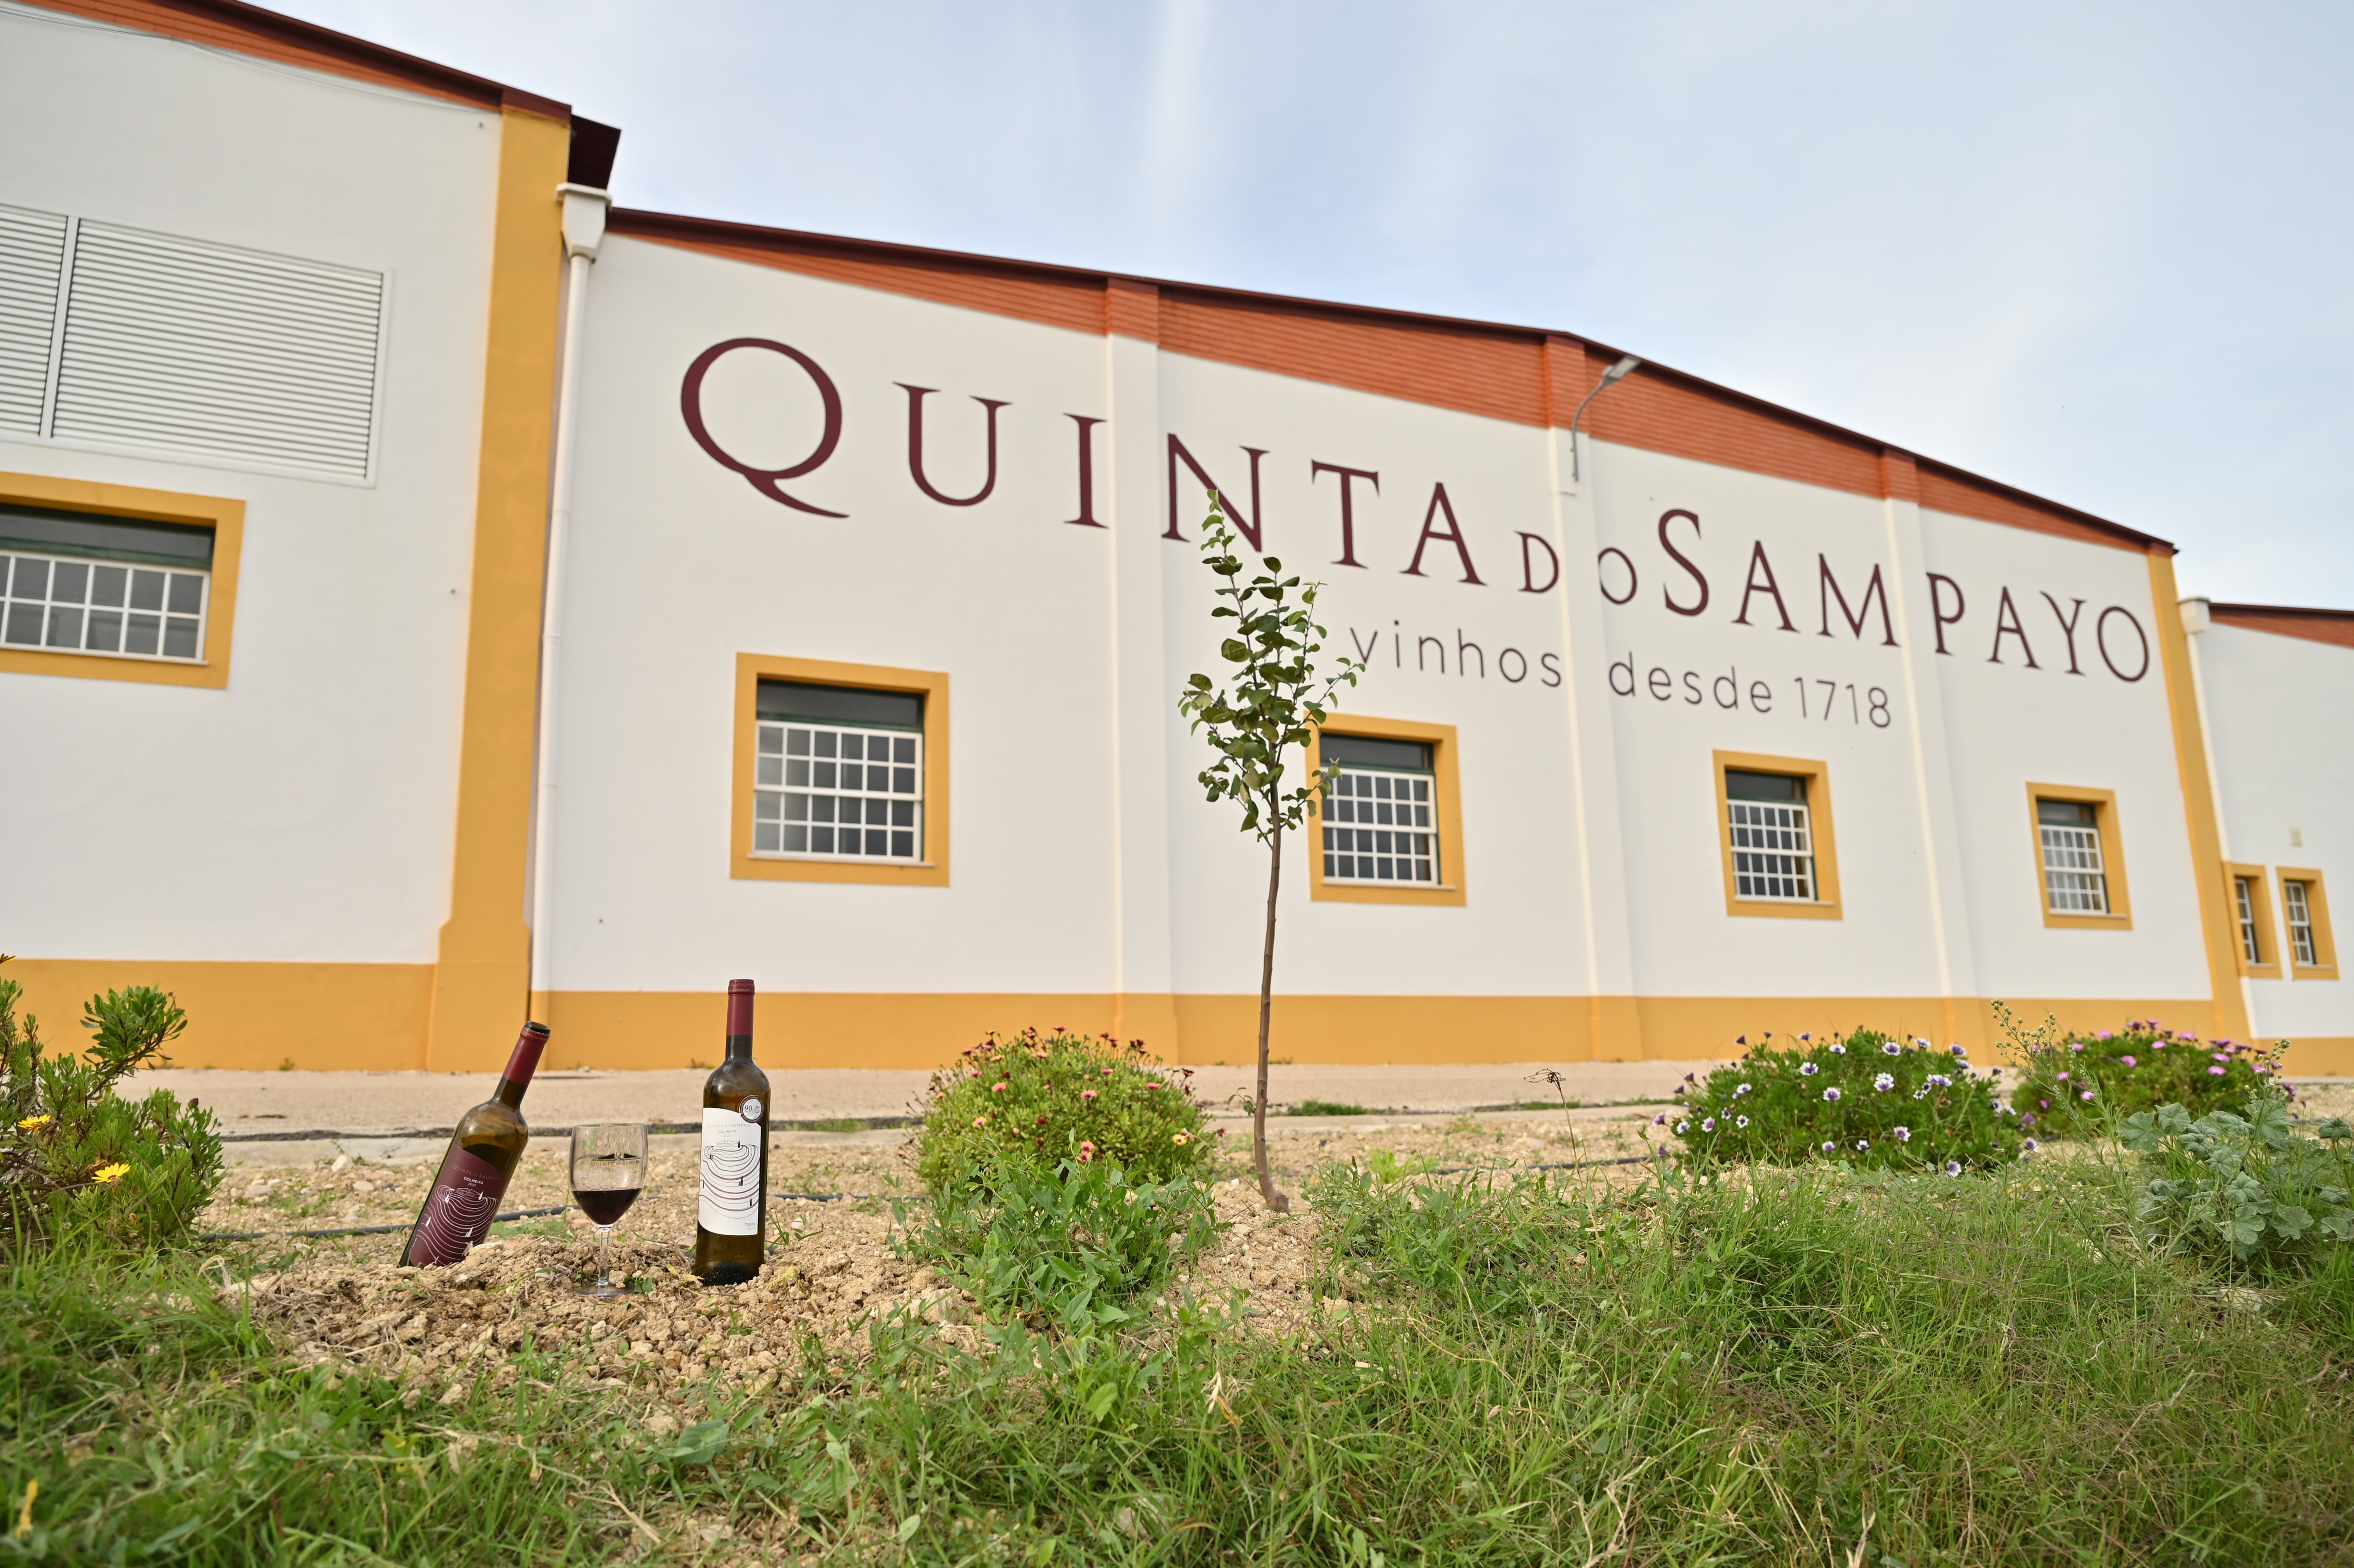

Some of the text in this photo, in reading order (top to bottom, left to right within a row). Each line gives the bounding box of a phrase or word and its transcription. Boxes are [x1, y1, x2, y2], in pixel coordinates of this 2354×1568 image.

[681, 337, 1487, 586] QUINTA
[1658, 508, 2149, 683] SAMPAYO
[1608, 651, 1772, 713] desde
[1795, 677, 1891, 728] 1718
[453, 1165, 472, 1175] QUINTA
